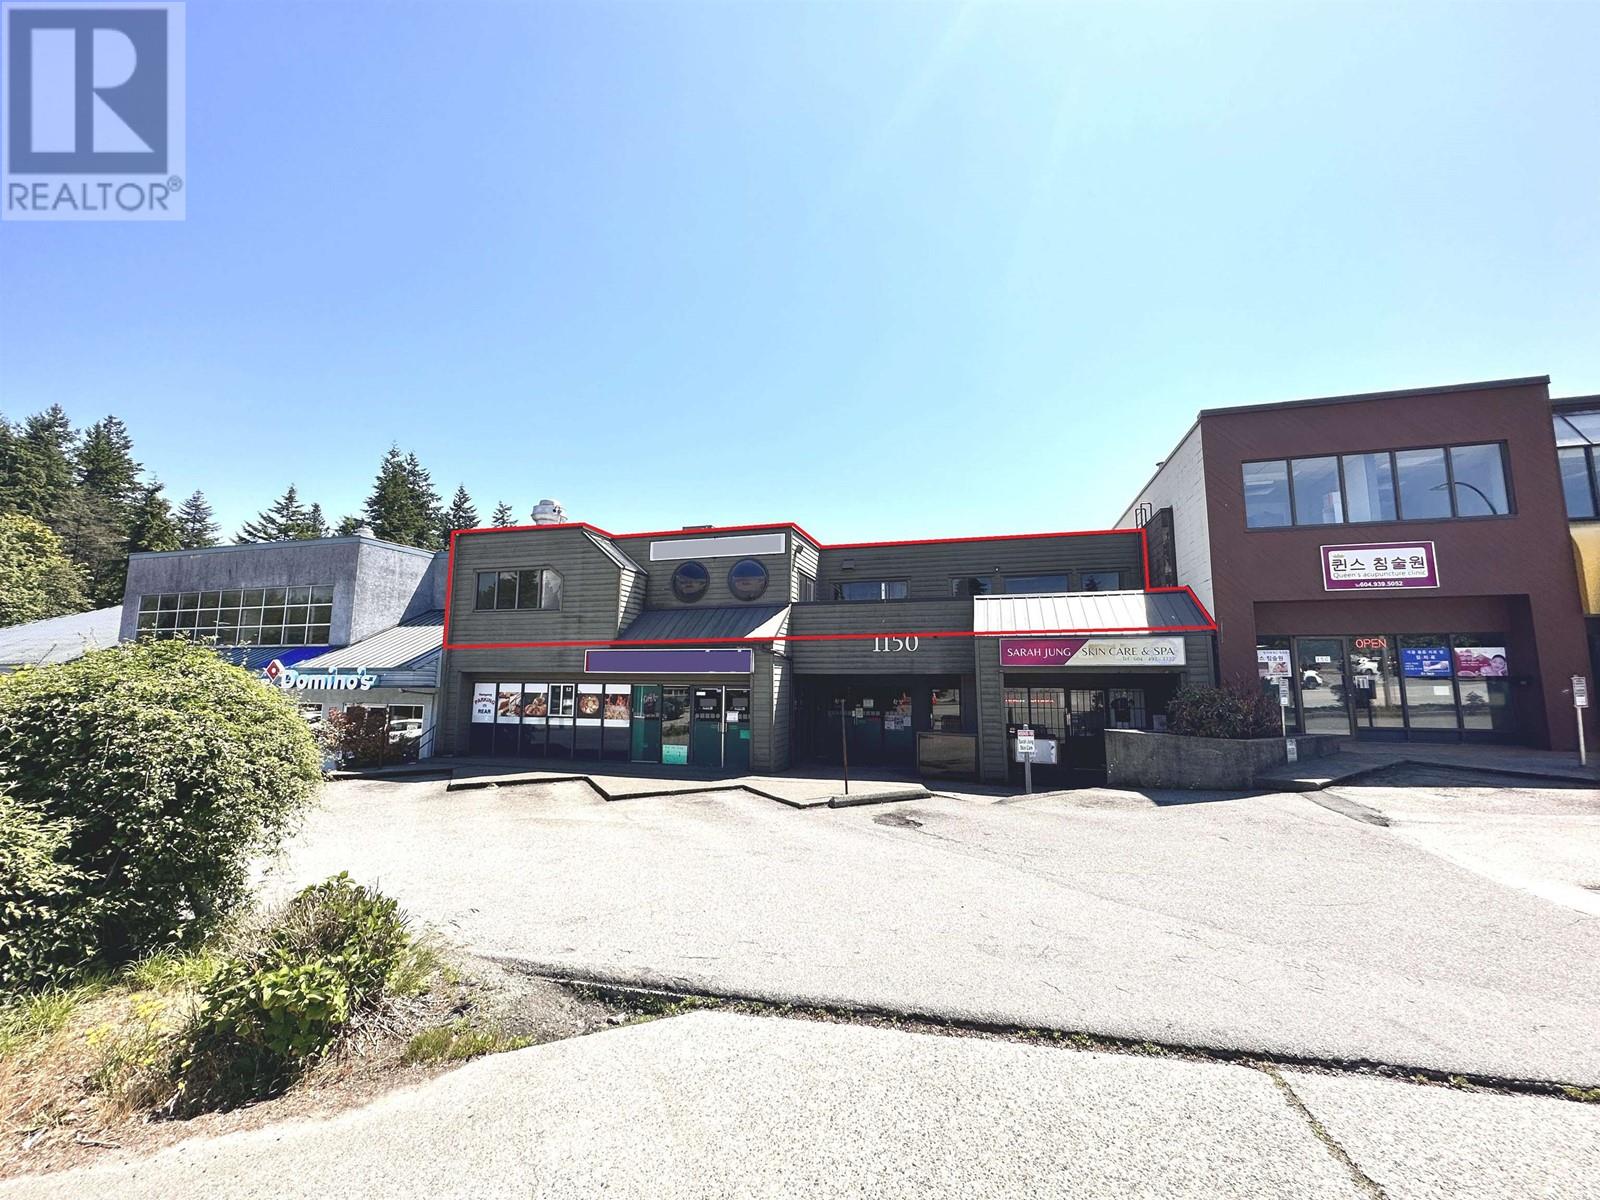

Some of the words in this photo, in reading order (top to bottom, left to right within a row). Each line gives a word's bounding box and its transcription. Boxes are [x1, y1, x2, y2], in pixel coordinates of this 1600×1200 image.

[1331, 558, 1366, 572] 퀸스
[1373, 555, 1425, 571] 침술원
[1333, 571, 1361, 579] Queen's
[1362, 570, 1406, 579] acupuncture
[873, 636, 919, 652] 1150
[1355, 638, 1387, 649] OPEN
[1007, 647, 1041, 657] SARAH
[1043, 647, 1071, 659] JUNG
[1081, 647, 1106, 656] SKIN
[1108, 647, 1137, 656] CARE
[1141, 647, 1151, 656] &
[1154, 647, 1175, 656] SPA
[280, 666, 376, 691] Domino's
